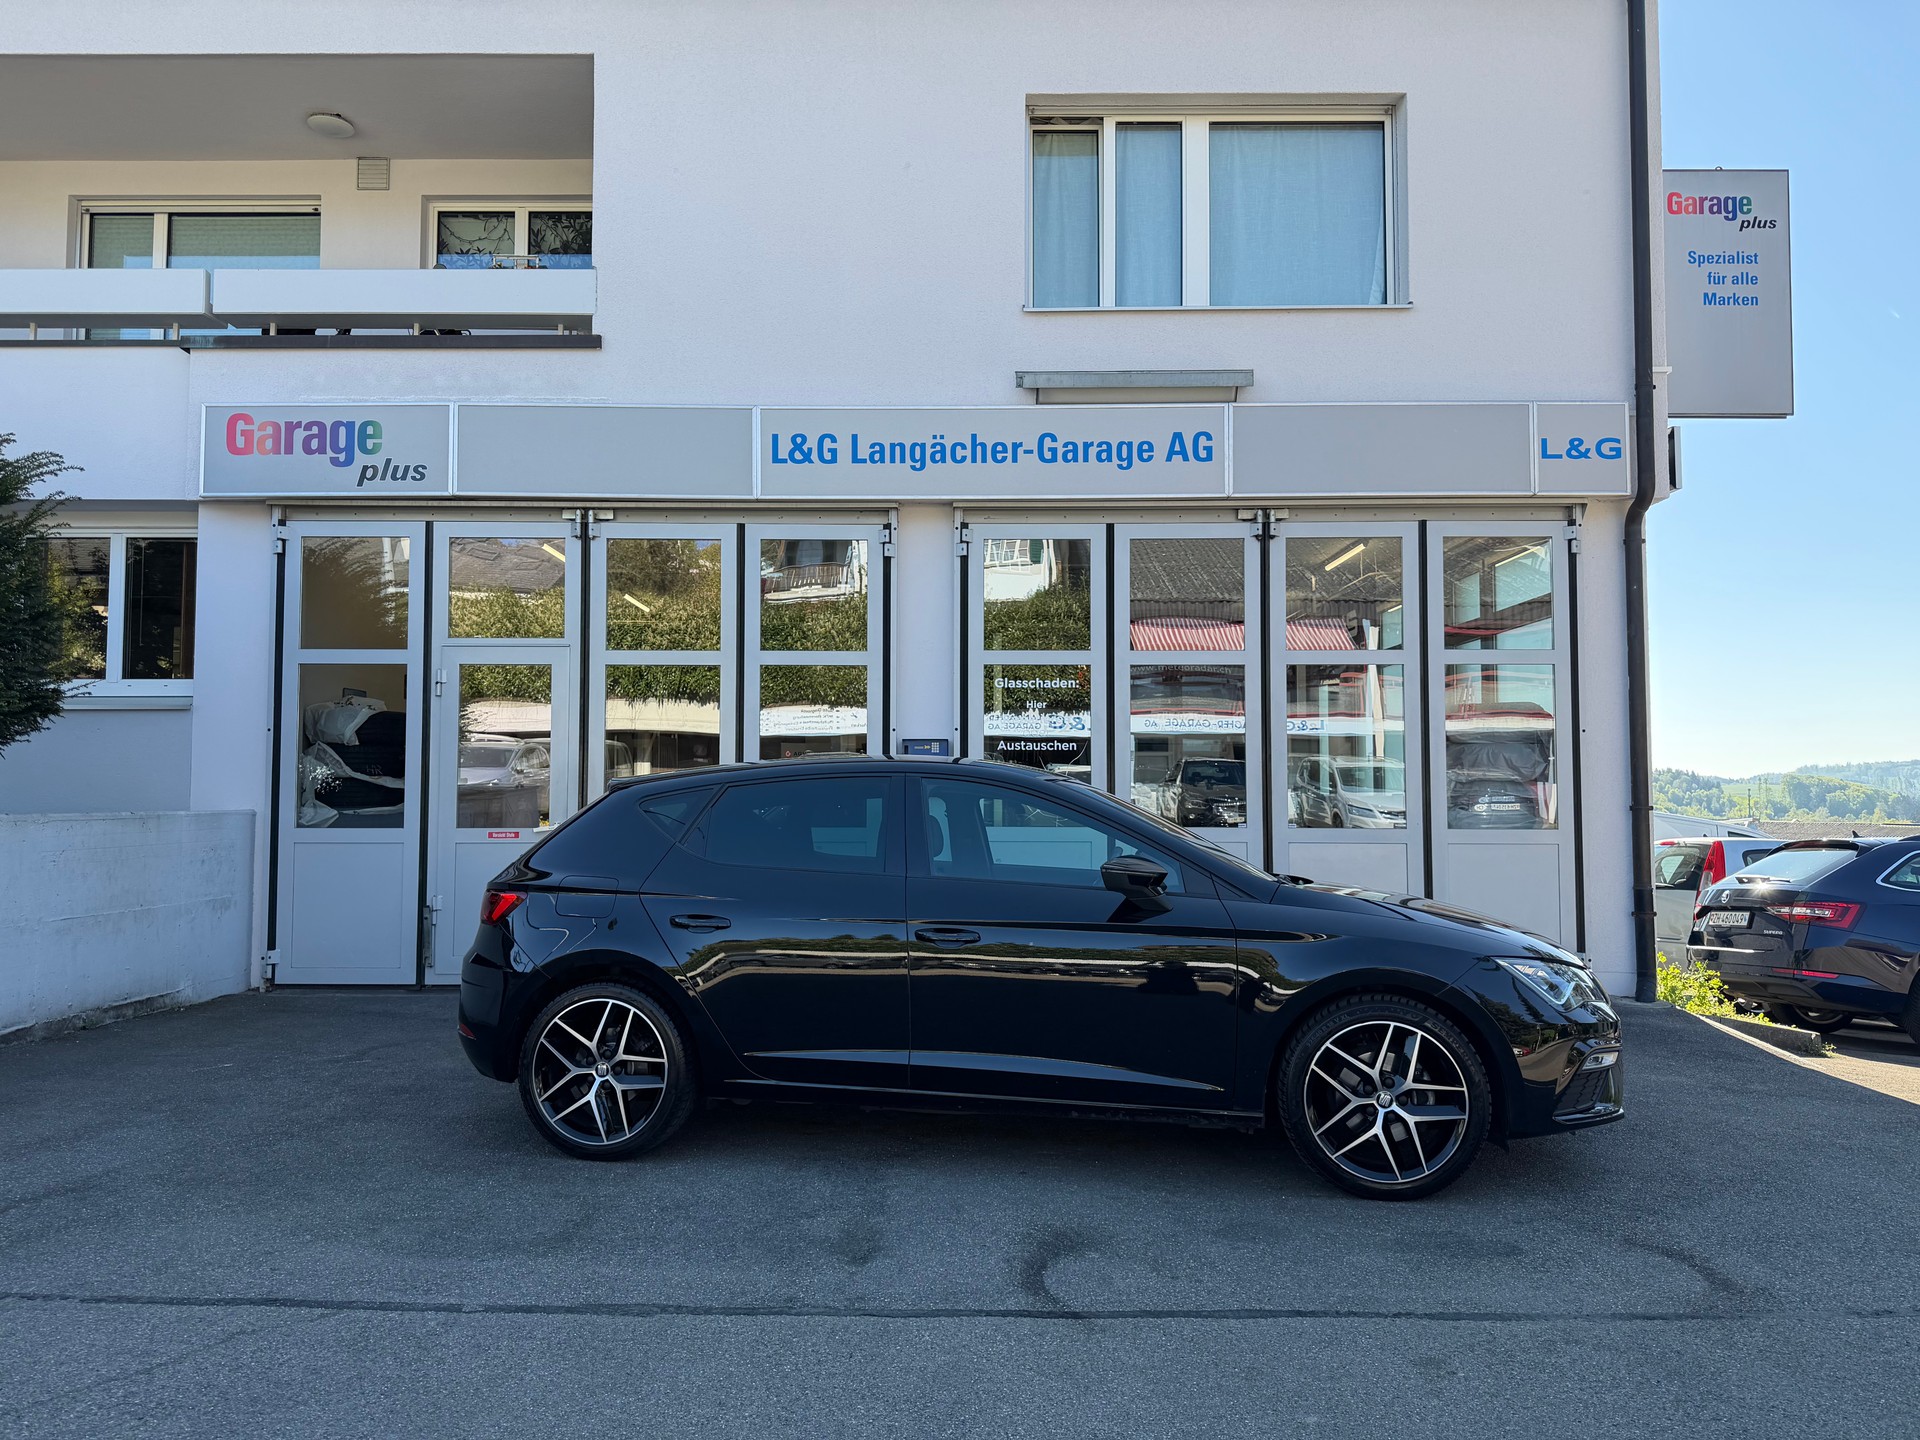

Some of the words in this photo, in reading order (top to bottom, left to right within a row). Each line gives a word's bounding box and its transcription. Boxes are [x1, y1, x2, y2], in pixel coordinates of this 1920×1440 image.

[1667, 192, 1752, 221] Garage
[1739, 216, 1777, 232] plus
[1687, 250, 1759, 268] Spezialist
[1707, 271, 1727, 285] für
[1731, 271, 1758, 285] alle
[1703, 292, 1759, 306] Marken
[226, 412, 383, 468] Garage
[1540, 437, 1622, 460] L&G
[771, 432, 839, 465] L&G
[851, 432, 1155, 472] Langächer-Garage
[1165, 431, 1214, 463] AG
[356, 458, 428, 488] plus
[994, 678, 1080, 689] Glasschaden:
[1026, 700, 1047, 709] Hier
[997, 740, 1077, 751] Austauschen
